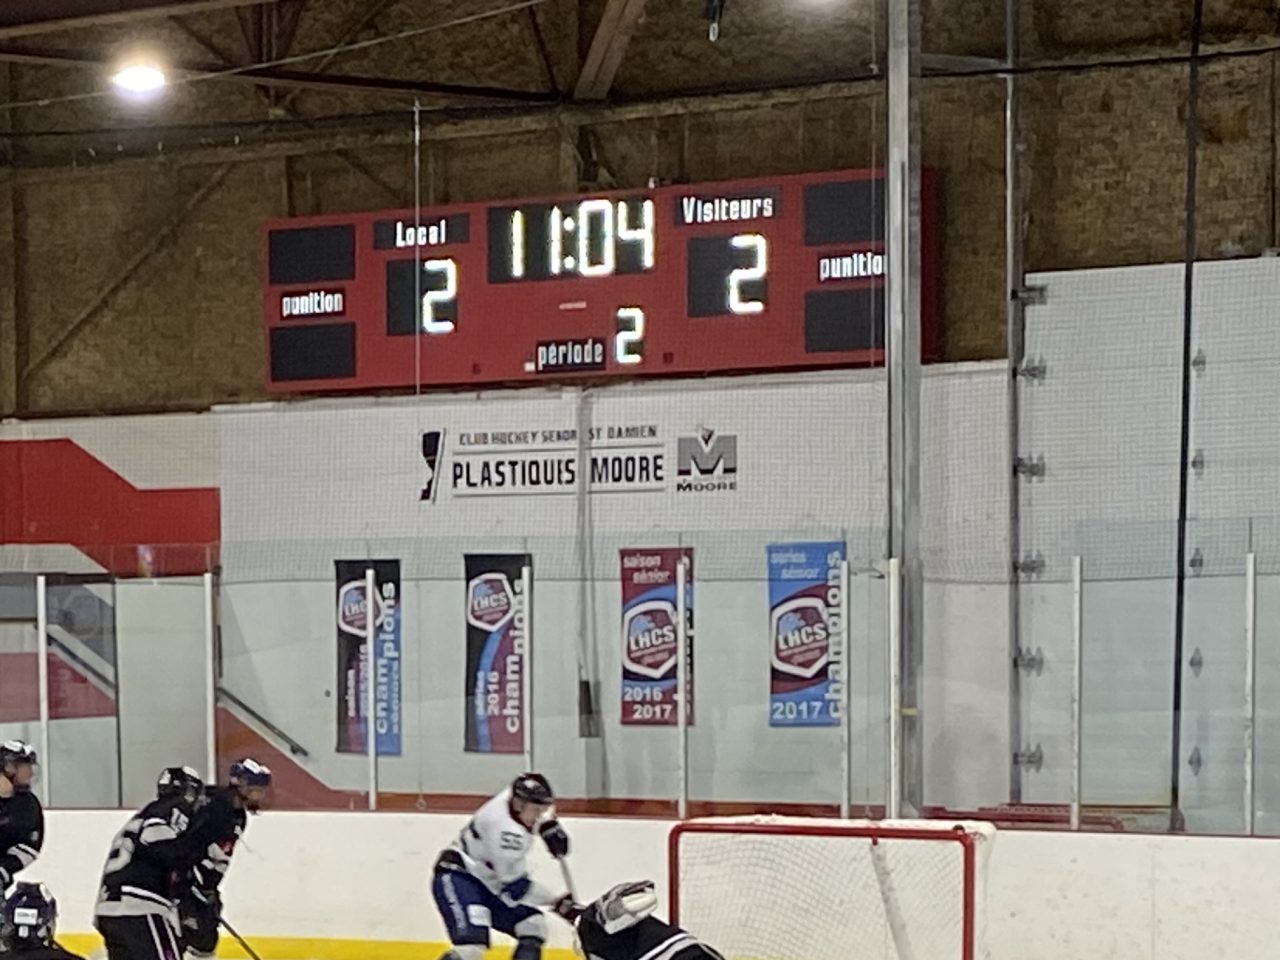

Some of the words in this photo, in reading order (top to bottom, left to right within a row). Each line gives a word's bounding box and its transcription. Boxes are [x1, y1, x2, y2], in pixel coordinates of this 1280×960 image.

[682, 196, 773, 224] Visiteurs
[395, 218, 447, 248] Local
[511, 198, 655, 278] 11:04
[729, 233, 767, 314] 2
[820, 252, 886, 282] punitio
[282, 290, 344, 317] punition
[422, 257, 458, 333] 2
[616, 307, 644, 364] 2
[591, 454, 664, 484] MOORE
[629, 624, 676, 652] LHCS
[777, 622, 828, 651] LHCS
[623, 686, 663, 702] 2016
[632, 703, 673, 720] 2017
[772, 701, 824, 720] 2017
